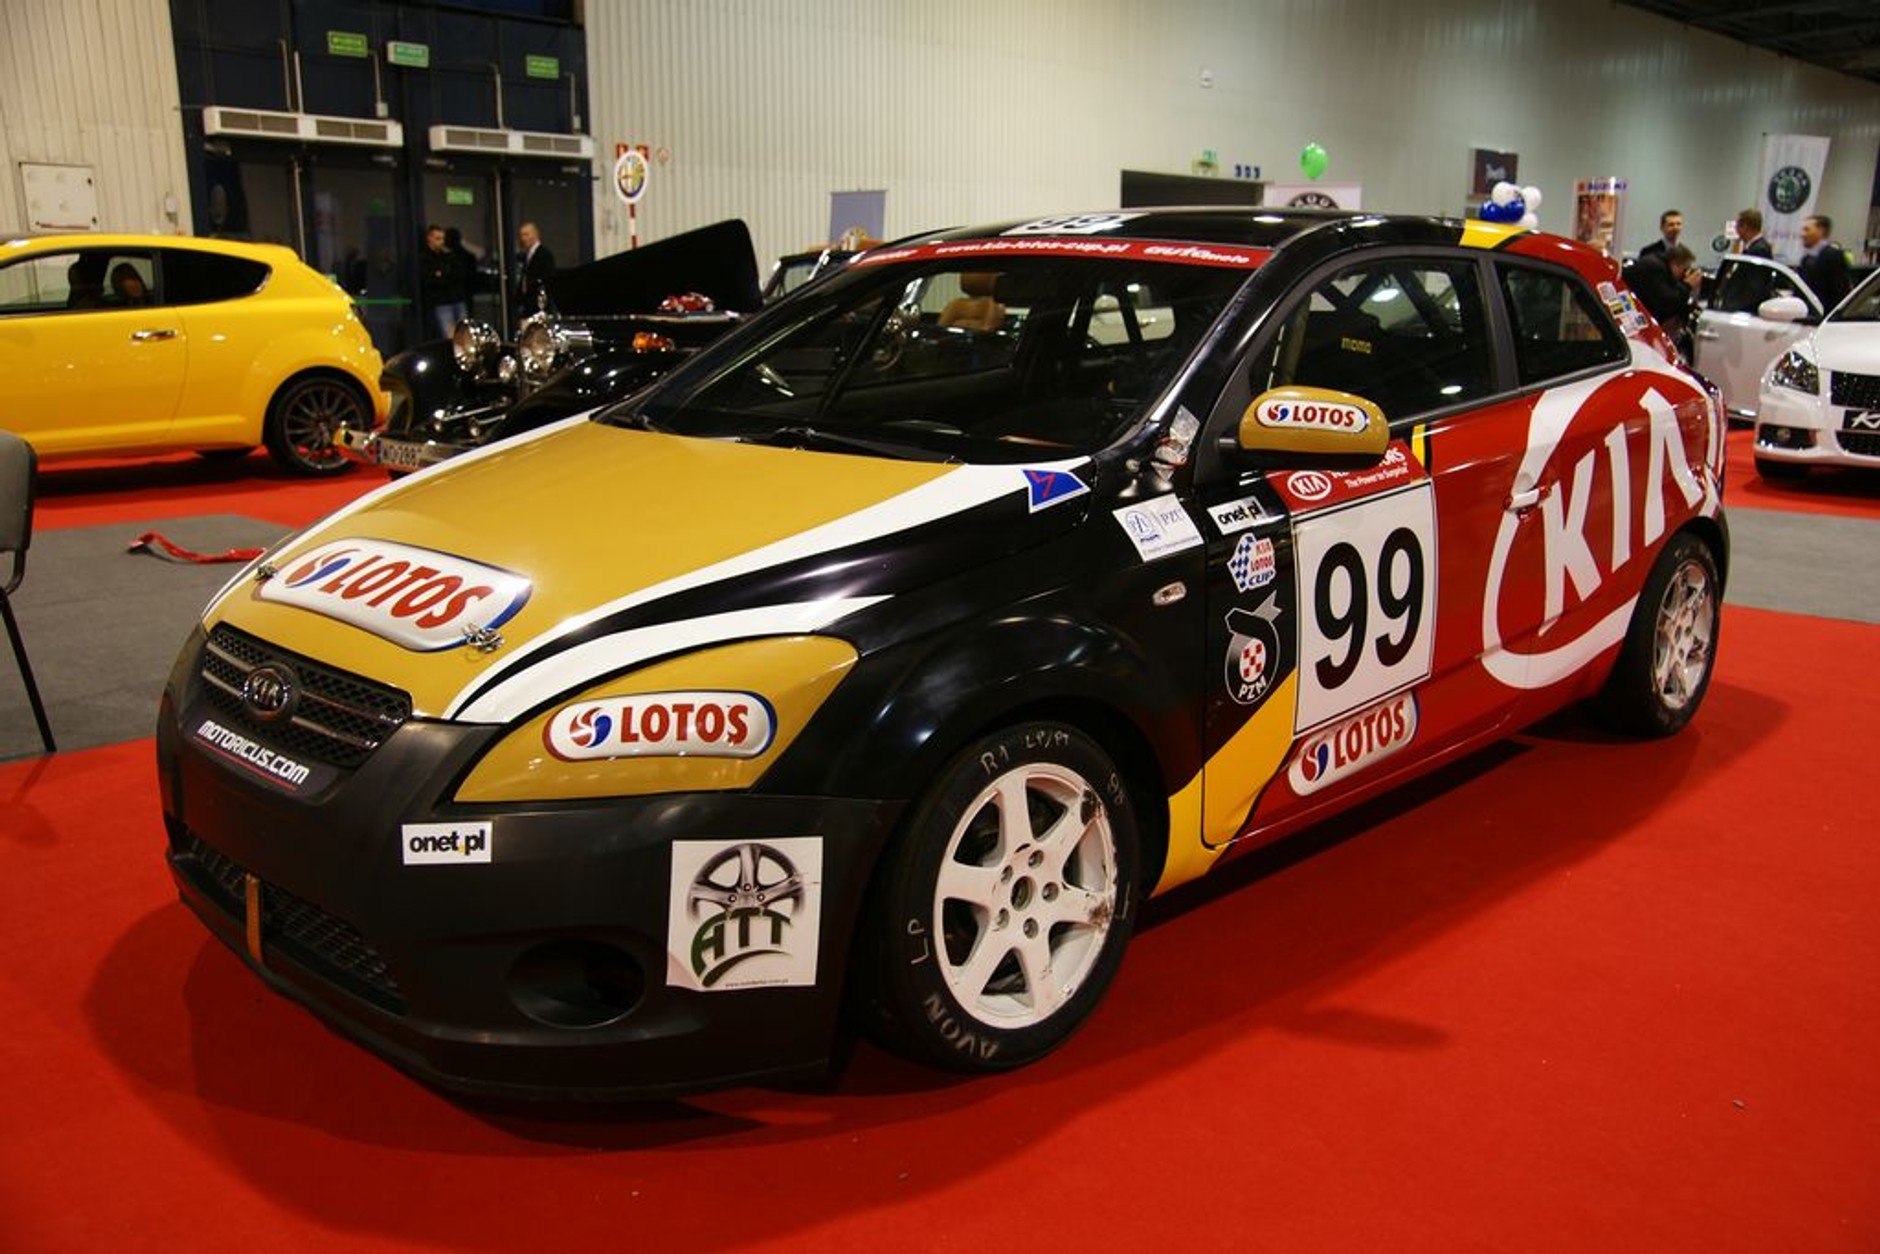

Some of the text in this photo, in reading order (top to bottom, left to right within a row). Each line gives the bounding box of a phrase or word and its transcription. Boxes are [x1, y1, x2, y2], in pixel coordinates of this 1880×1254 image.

[1293, 405, 1355, 427] LOTOS
[1294, 477, 1327, 495] KIA
[1538, 387, 1703, 637] KIA
[1249, 570, 1274, 586] CUP
[1251, 557, 1274, 571] LOTOS
[318, 555, 494, 630] LOTOS
[1314, 527, 1425, 690] 99
[1238, 675, 1268, 700] PZM
[620, 703, 749, 745] LOTOS
[1333, 700, 1406, 770] LOTOS
[197, 719, 310, 784] MOTORICUS.COM
[409, 829, 486, 856] onet.pl
[924, 993, 1000, 1058] AVON
